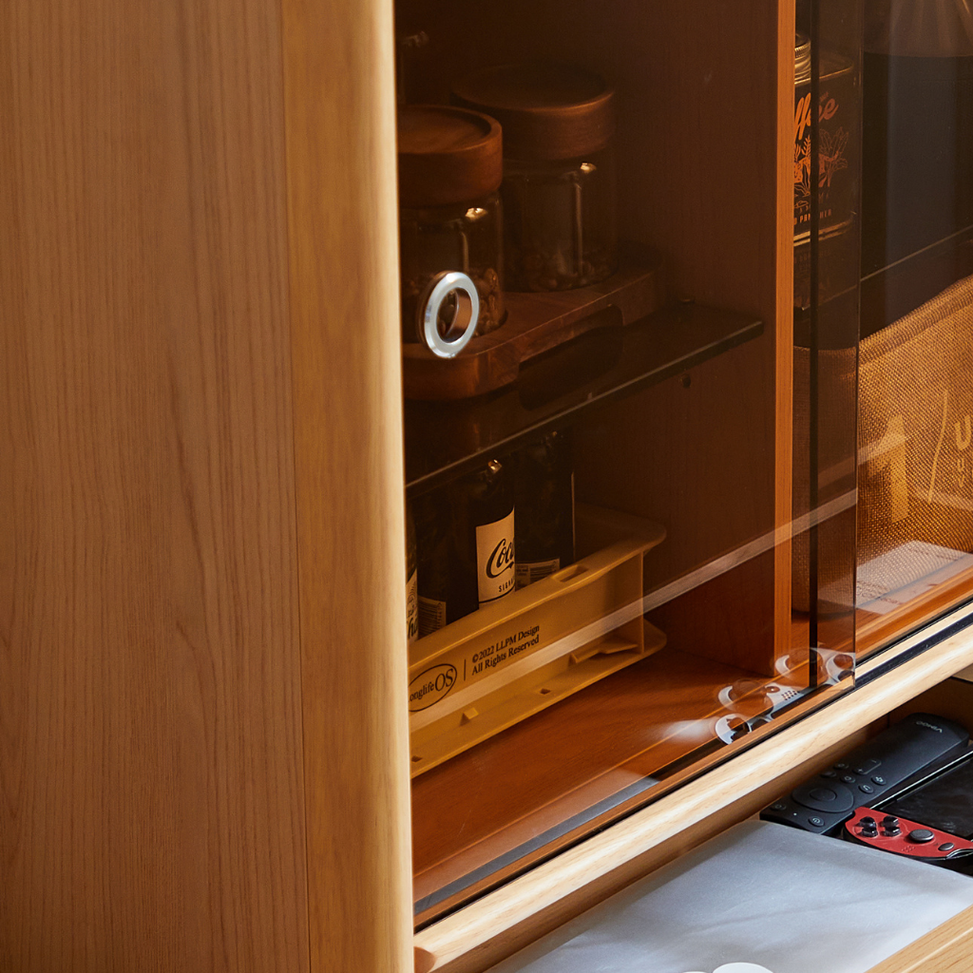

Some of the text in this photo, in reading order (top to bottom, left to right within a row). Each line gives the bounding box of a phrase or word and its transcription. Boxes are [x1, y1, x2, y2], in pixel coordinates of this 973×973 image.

[472, 634, 540, 676] All Rights Reserved
[496, 635, 517, 653] LLPM
[518, 625, 540, 640] Design
